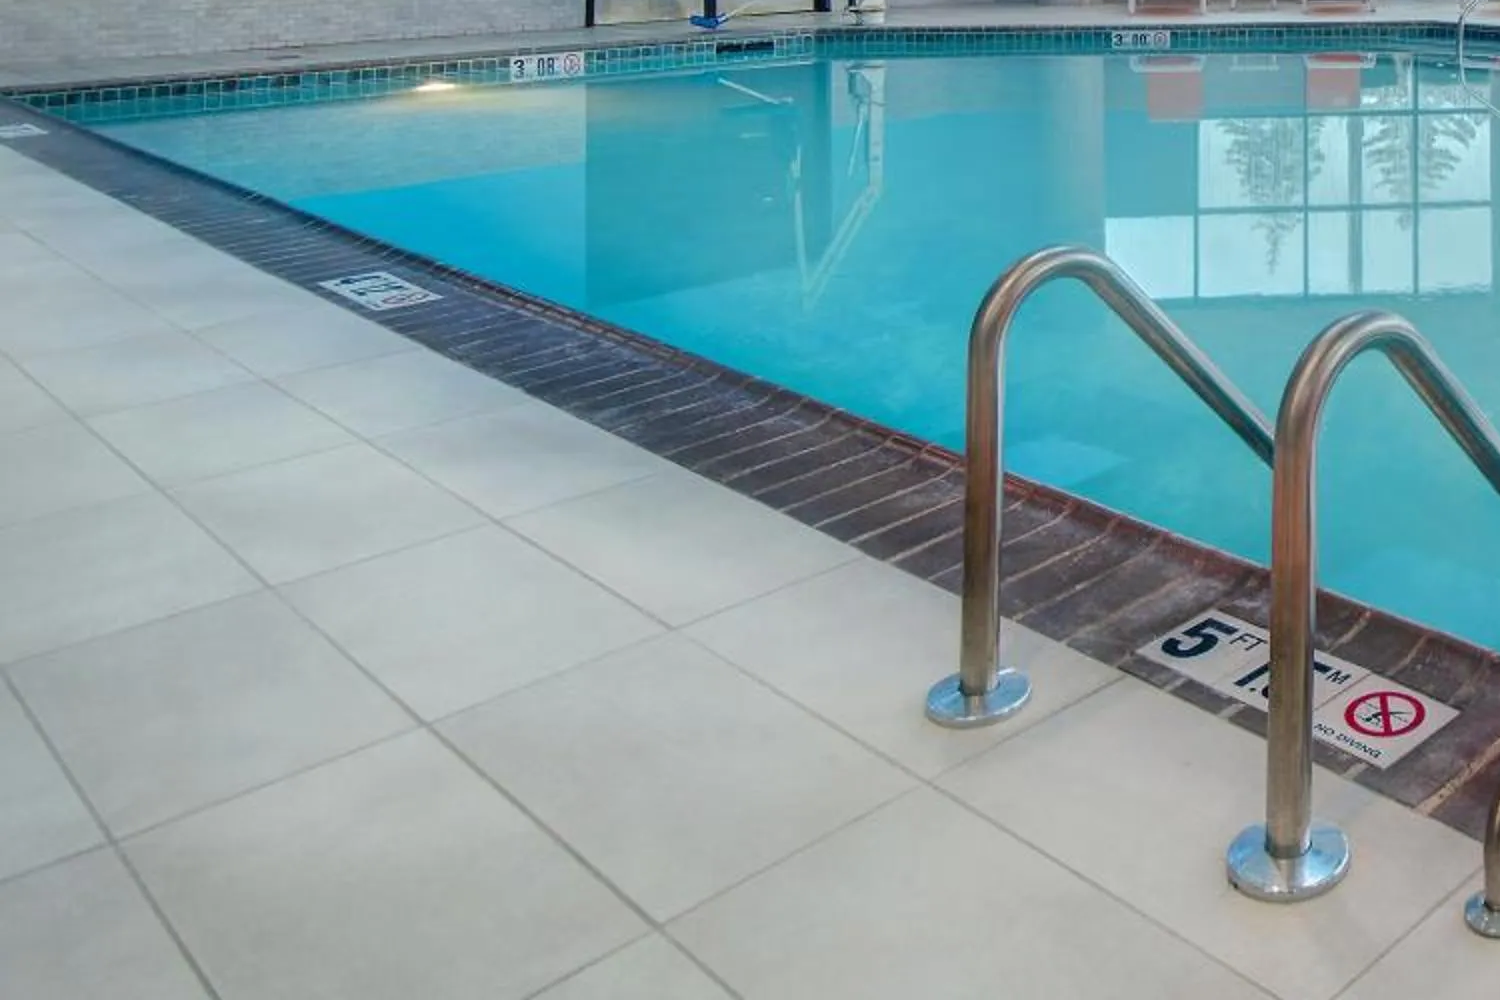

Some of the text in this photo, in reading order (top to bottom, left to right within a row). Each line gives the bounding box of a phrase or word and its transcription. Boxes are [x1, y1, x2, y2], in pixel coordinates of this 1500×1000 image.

[1161, 617, 1239, 659] 5
[1229, 632, 1268, 651] FT
[1325, 669, 1352, 685] M
[1313, 722, 1382, 759] NO DIVING
